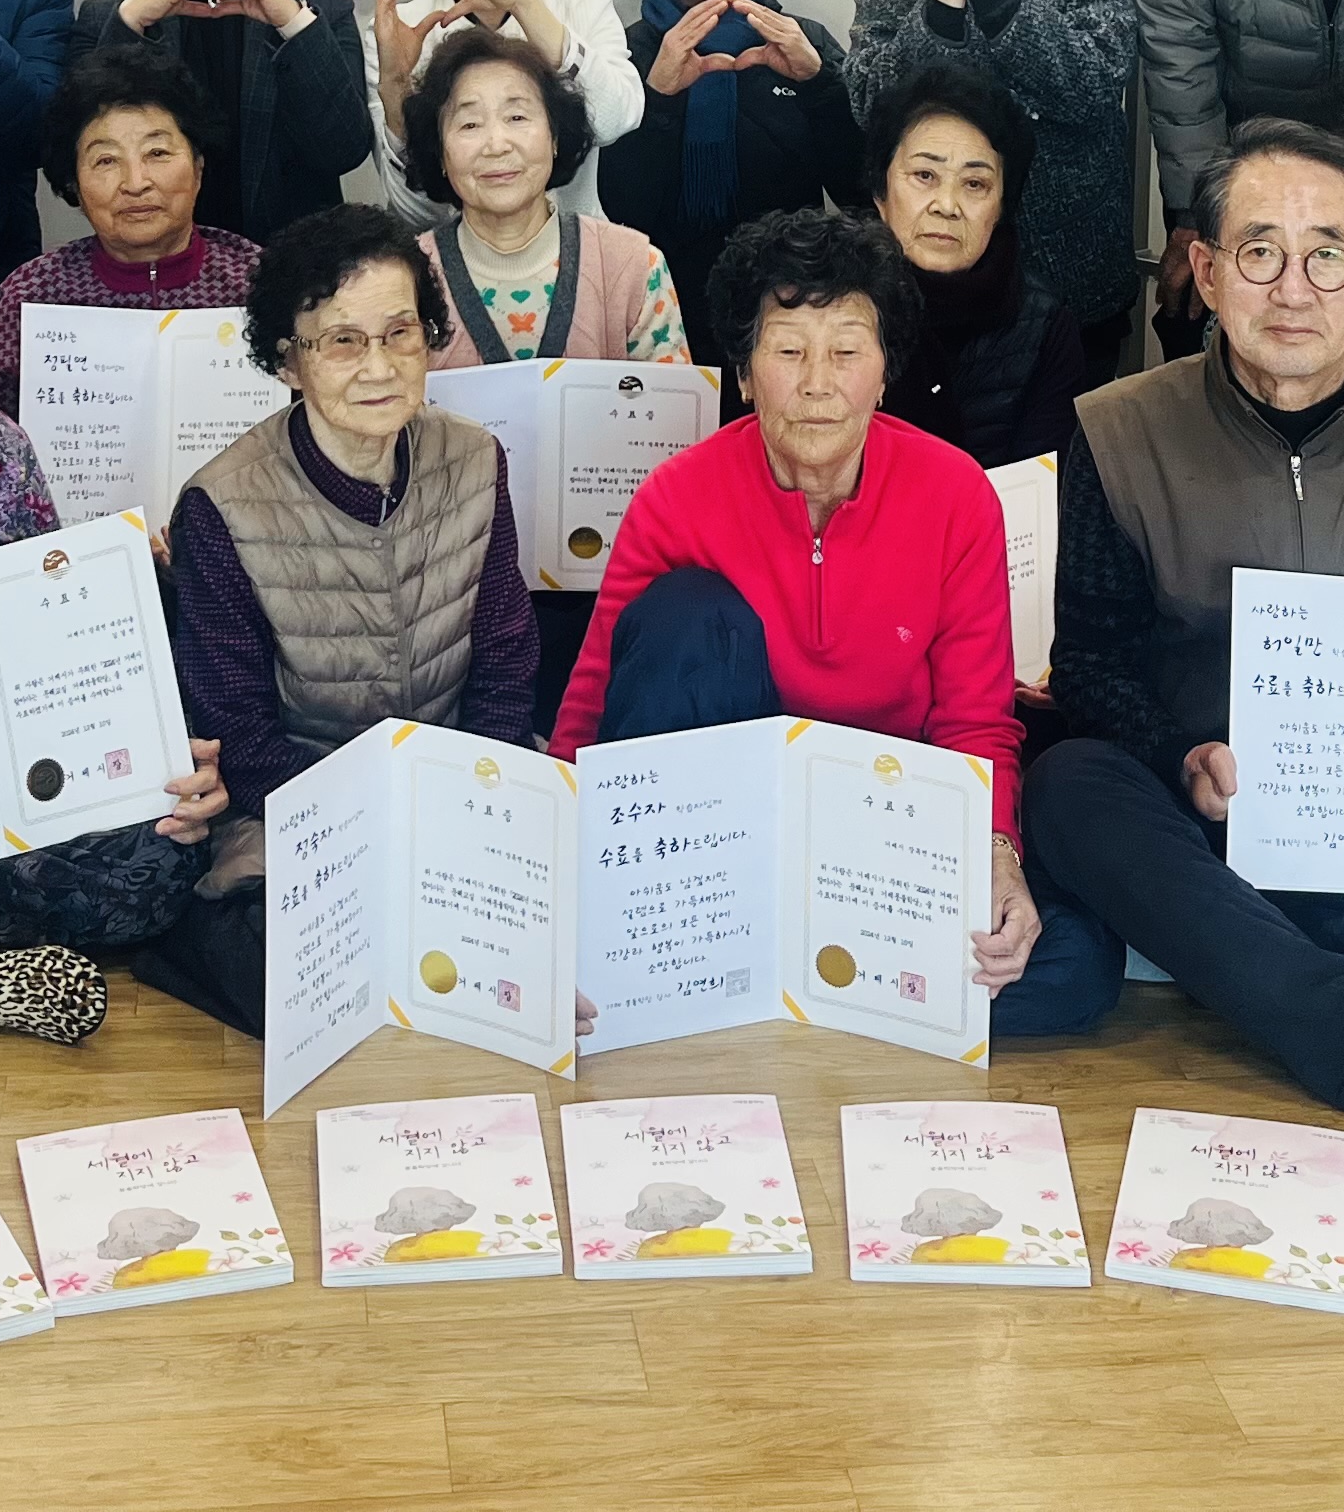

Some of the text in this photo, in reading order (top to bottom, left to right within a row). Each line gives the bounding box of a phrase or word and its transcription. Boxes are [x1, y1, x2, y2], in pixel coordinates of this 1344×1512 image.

[379, 1127, 442, 1148] 세월에
[624, 1125, 688, 1146] 세월에
[651, 1133, 733, 1157] 지지 않고
[904, 1128, 968, 1148] 세월에
[404, 1136, 488, 1161] 지지 않고
[930, 1141, 1012, 1161] 지지 않고
[1190, 1144, 1257, 1162] 세월에
[87, 1147, 154, 1173] 세월에
[116, 1153, 199, 1182] 지지 않고
[1215, 1161, 1300, 1178] 지지 않고
